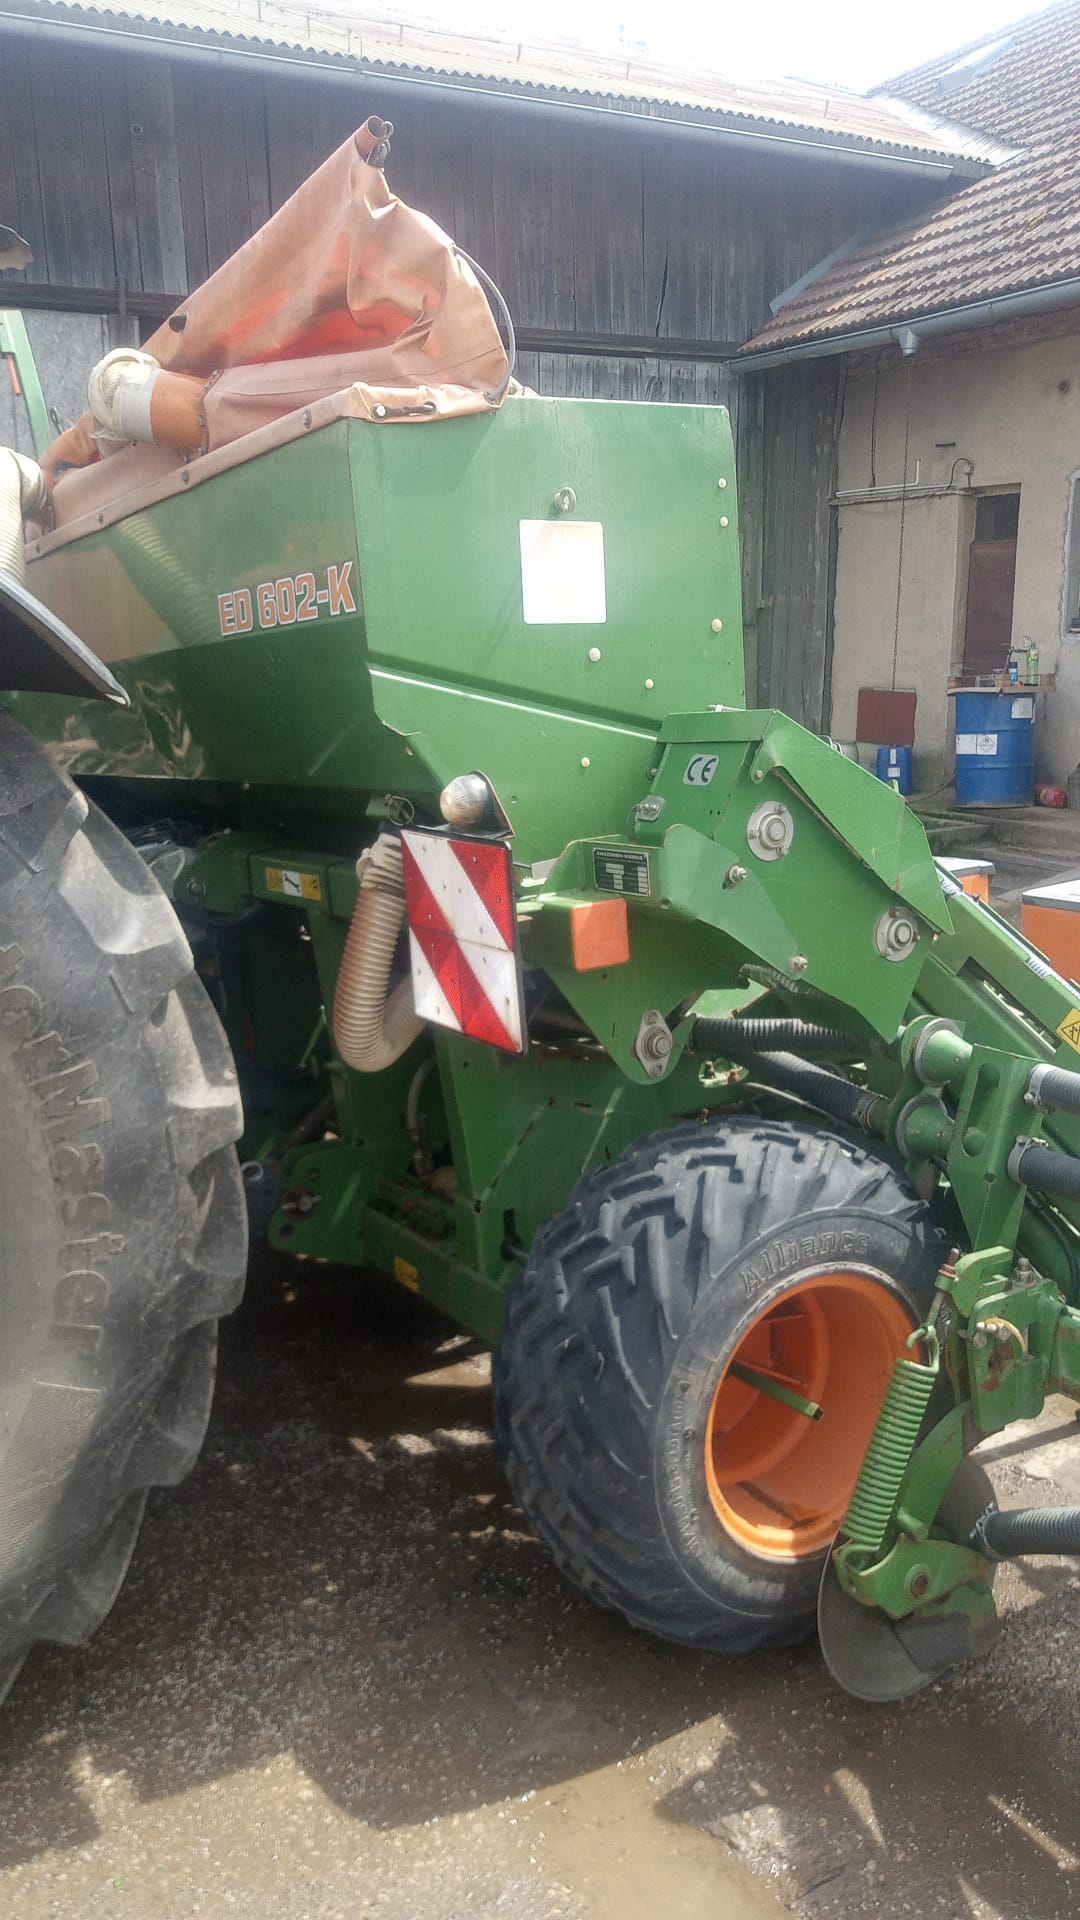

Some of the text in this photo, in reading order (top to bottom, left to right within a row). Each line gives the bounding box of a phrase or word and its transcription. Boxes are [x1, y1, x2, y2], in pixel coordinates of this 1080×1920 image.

[218, 561, 357, 636] ED 602-K
[687, 756, 717, 783] CE
[739, 1229, 872, 1299] Alliance
